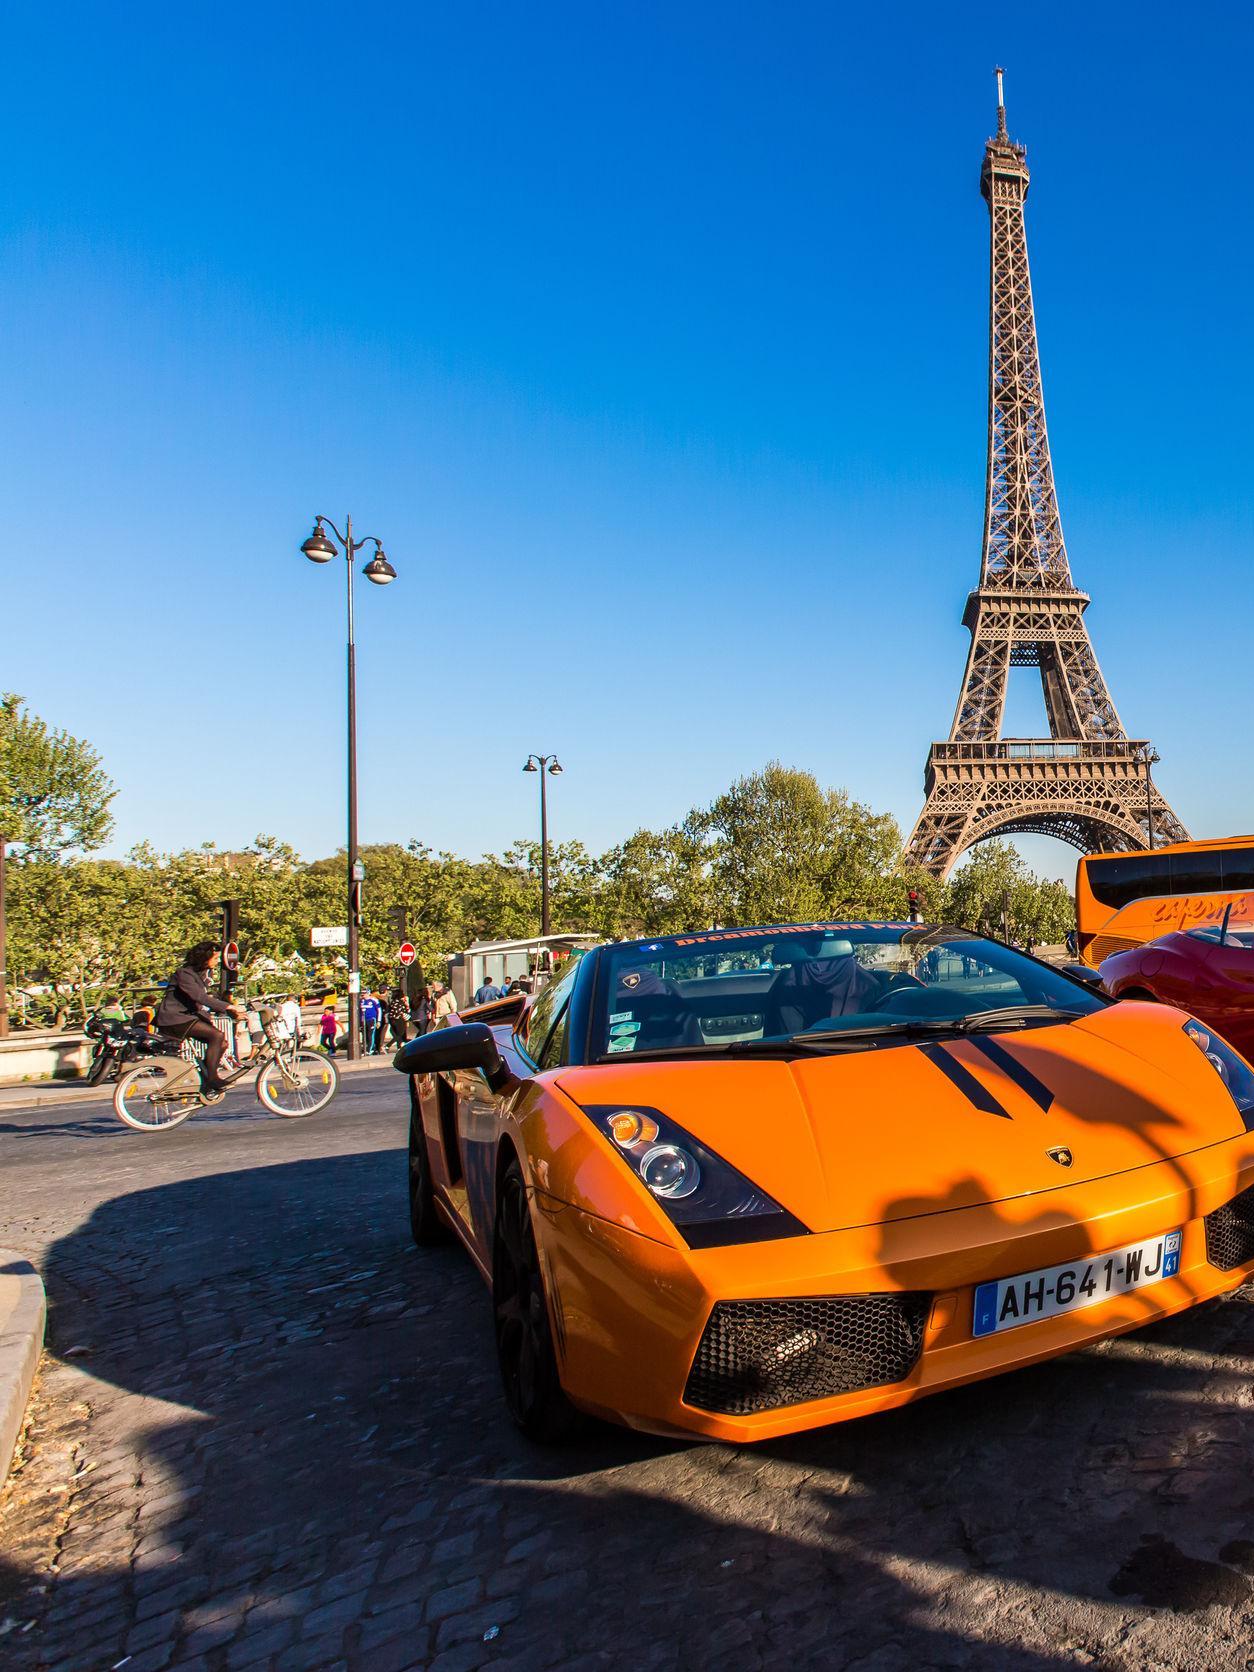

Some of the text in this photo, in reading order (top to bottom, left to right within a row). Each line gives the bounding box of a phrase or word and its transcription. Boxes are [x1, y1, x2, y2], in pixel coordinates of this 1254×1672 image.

[1165, 1255, 1177, 1273] 41
[998, 1242, 1164, 1322] AH-641-WJ
[982, 1314, 989, 1326] F
